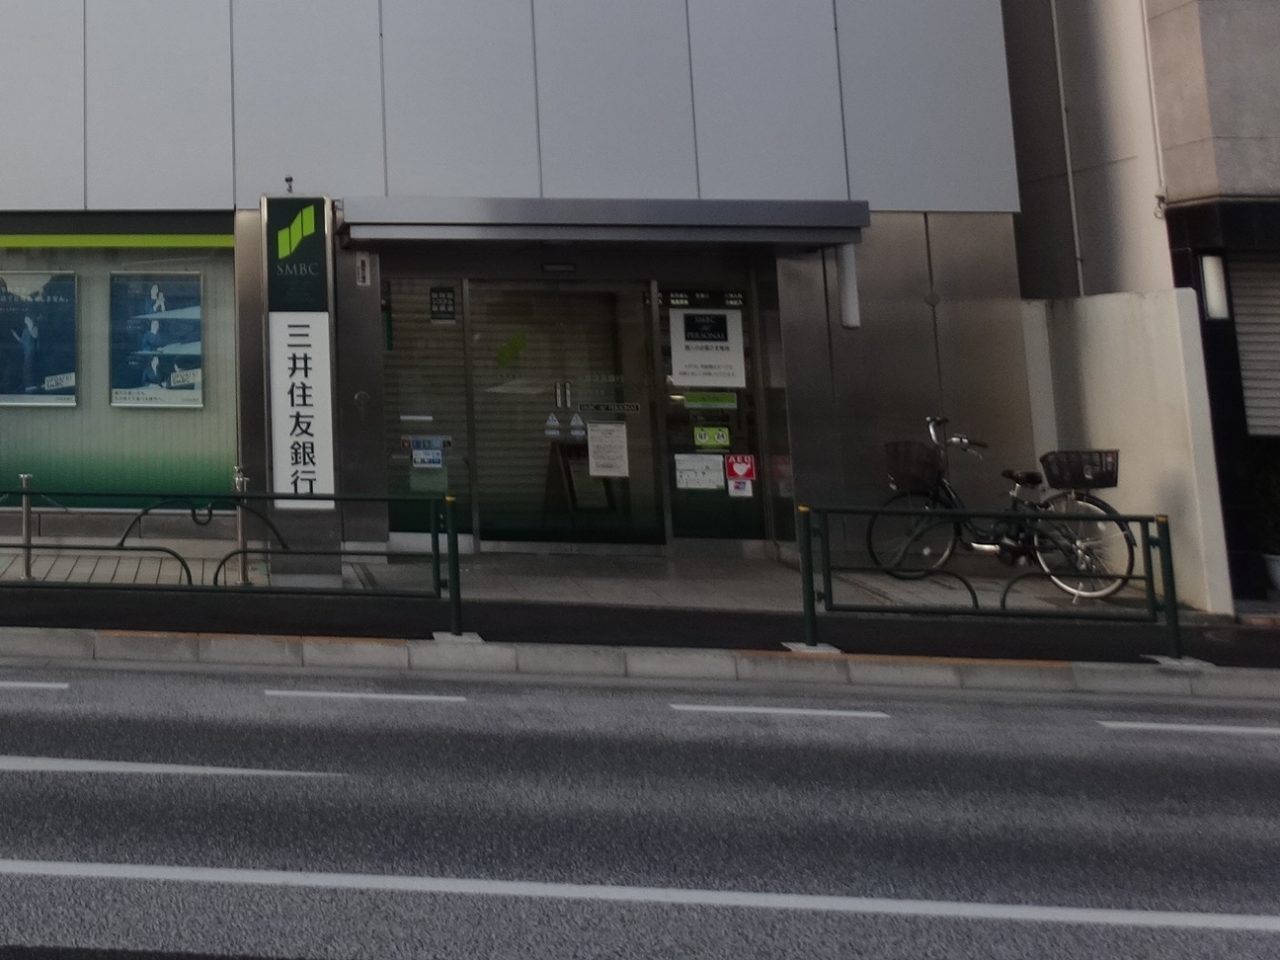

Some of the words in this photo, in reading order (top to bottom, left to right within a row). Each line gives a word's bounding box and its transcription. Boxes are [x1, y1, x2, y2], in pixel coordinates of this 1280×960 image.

[276, 262, 319, 276] SMBC
[287, 324, 317, 494] 三井住友銀行
[728, 455, 752, 464] AED
